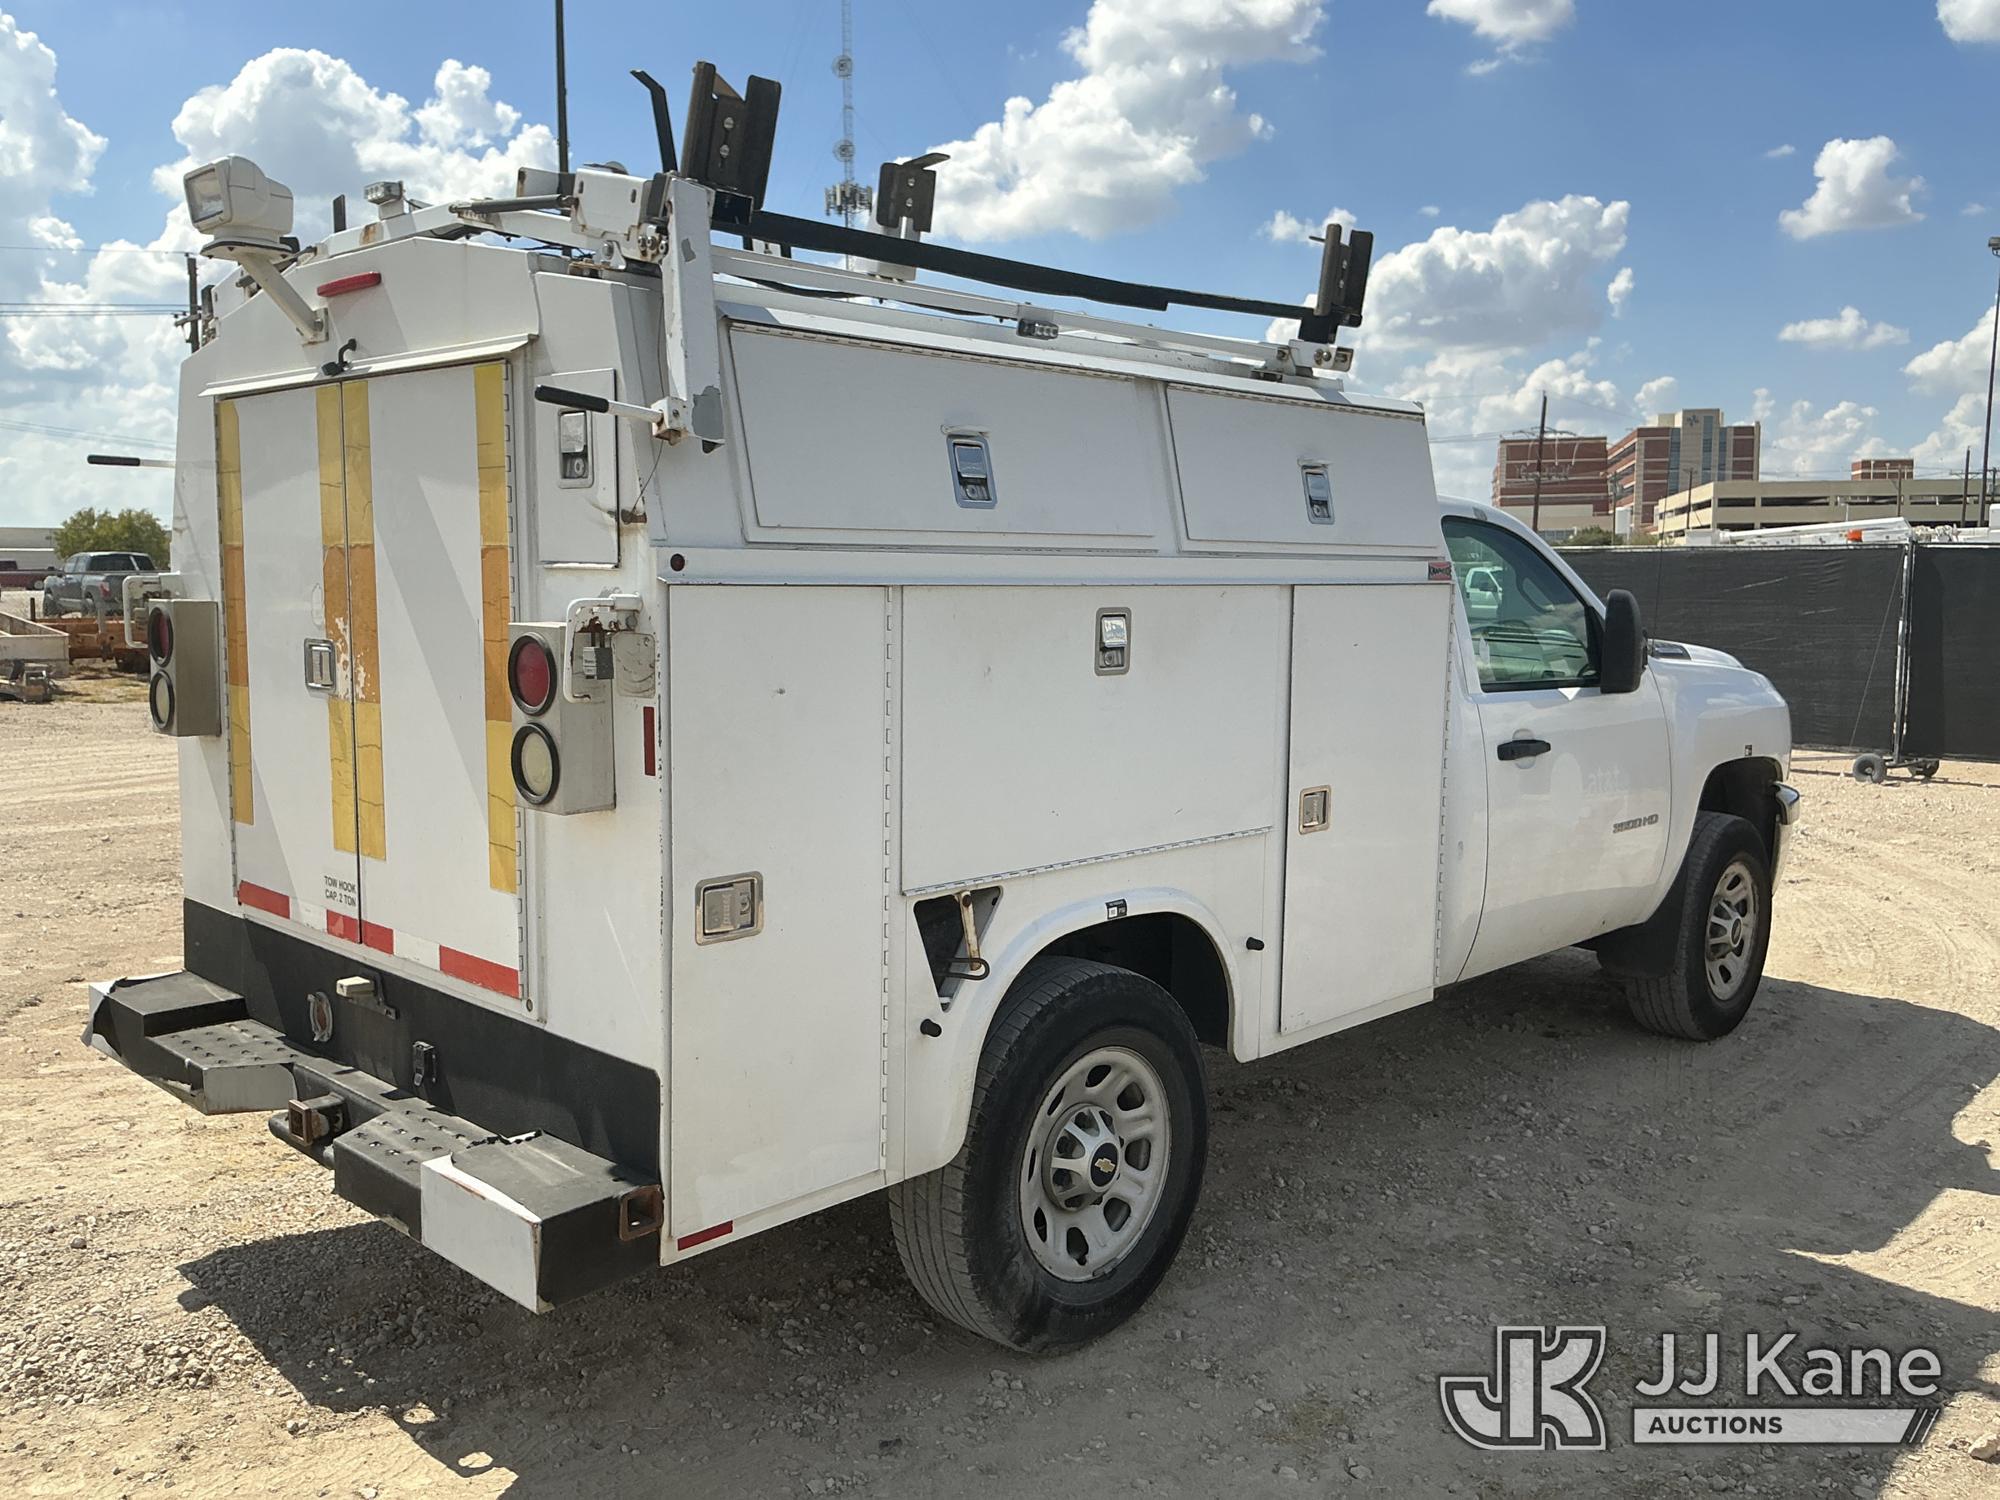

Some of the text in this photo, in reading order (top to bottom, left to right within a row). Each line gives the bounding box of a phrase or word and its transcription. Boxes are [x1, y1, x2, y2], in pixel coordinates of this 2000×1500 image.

[324, 875, 356, 894] TOW HOOK
[344, 894, 356, 907] TON
